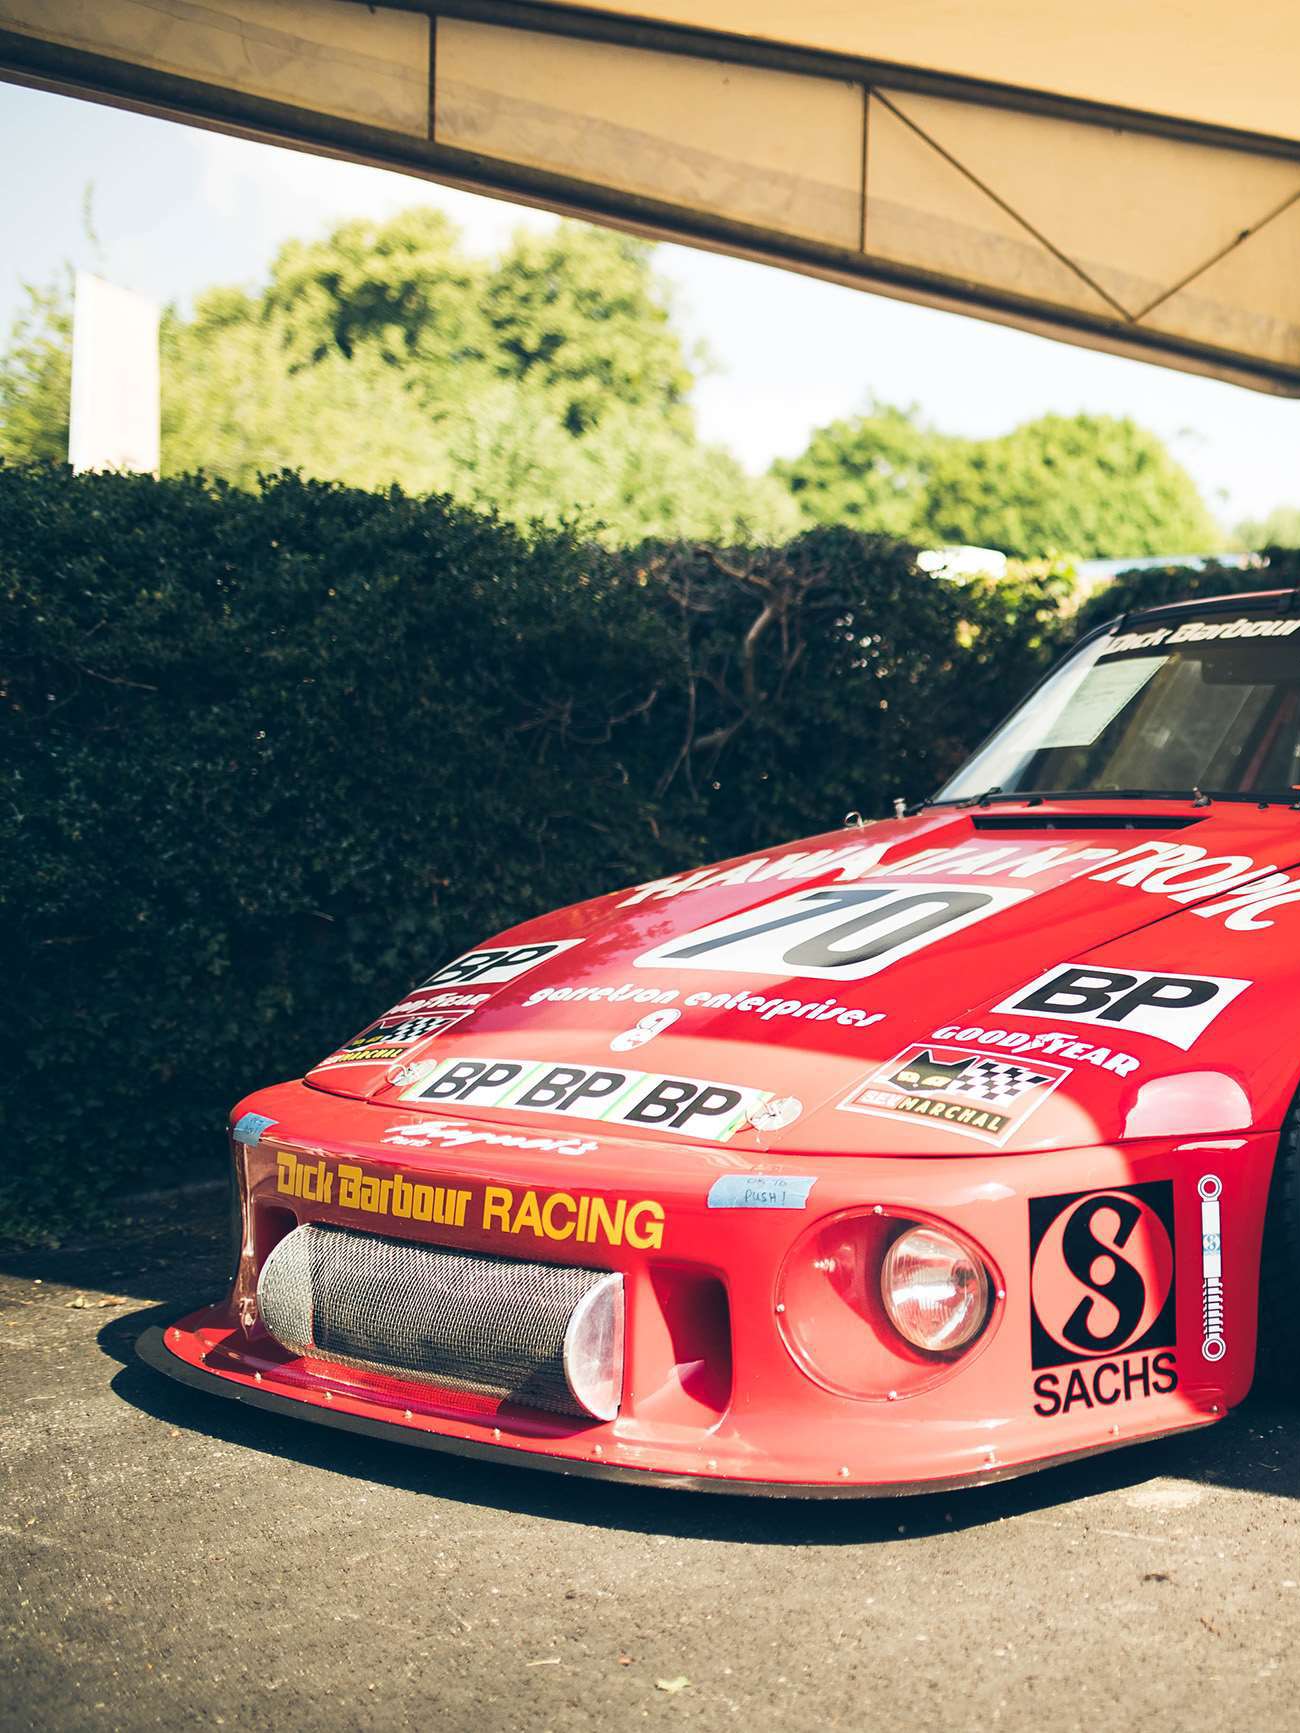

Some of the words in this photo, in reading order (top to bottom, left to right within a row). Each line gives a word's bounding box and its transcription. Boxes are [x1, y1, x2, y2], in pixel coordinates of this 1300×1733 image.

[660, 889, 993, 968] 70
[425, 944, 560, 987] BP
[521, 983, 681, 1007] garretson
[684, 991, 888, 1028] enterprises
[1011, 968, 1220, 1023] BP
[931, 1025, 1141, 1079] GOODYEAR
[419, 1061, 524, 1101] BP
[514, 1066, 627, 1112] BP
[623, 1078, 743, 1130] BP
[898, 1096, 1002, 1132] MARCHAL
[276, 1151, 333, 1205] Dick
[338, 1166, 470, 1228] Barbour
[482, 1188, 665, 1250] RACING
[1033, 1352, 1179, 1418] SACHS
